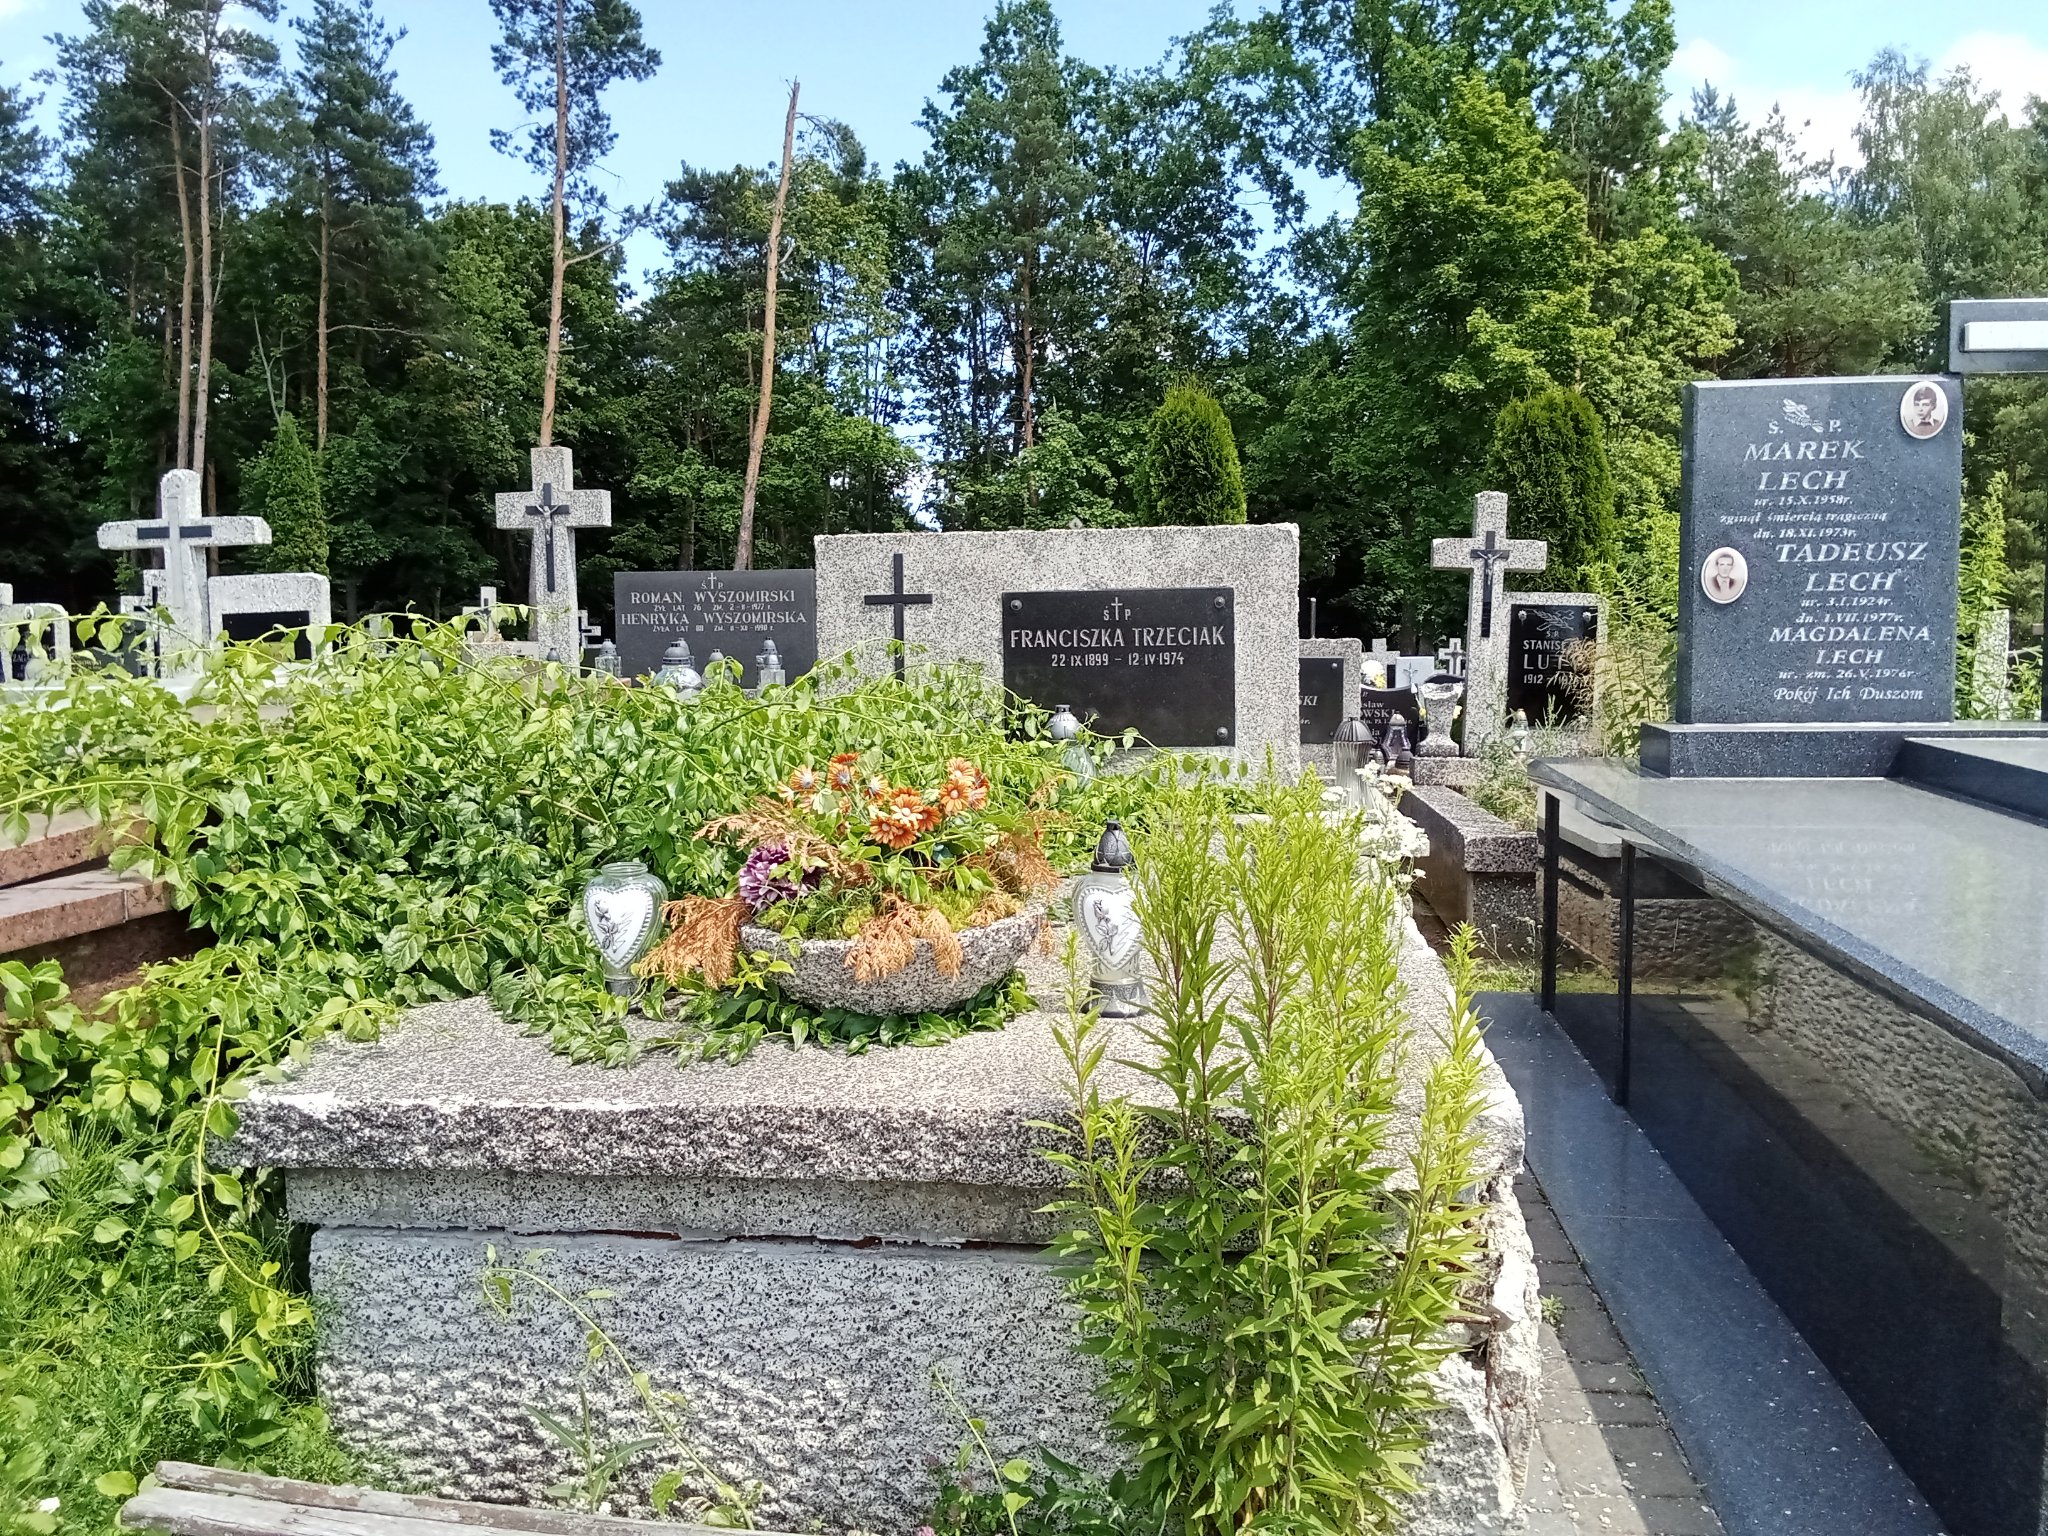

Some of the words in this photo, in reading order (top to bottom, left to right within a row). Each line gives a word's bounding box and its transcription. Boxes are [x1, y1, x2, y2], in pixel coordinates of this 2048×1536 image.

[1744, 439, 1865, 461] MAREK
[1758, 469, 1851, 491] LECH
[1753, 528, 1774, 539] dn.
[1775, 541, 1929, 563] TADEUSZ
[1805, 571, 1897, 592] LECH
[631, 591, 682, 604] ROMAN
[694, 590, 796, 603] WYSZOMIRSKI
[673, 604, 686, 612] LAT
[621, 613, 690, 625] HENRYKA
[703, 611, 807, 625] WYSZOMIRSKA
[1795, 612, 1818, 623] dn.
[1010, 628, 1125, 648] FRANCISZKA
[1132, 625, 1225, 647] TRZECIAK
[1769, 625, 1931, 643] MAGDALENA
[1815, 649, 1884, 664] LECH
[1523, 674, 1544, 684] 1912
[1773, 685, 1819, 704] Pokój
[1826, 685, 1852, 700] Ich
[1859, 686, 1924, 701] Duszom
